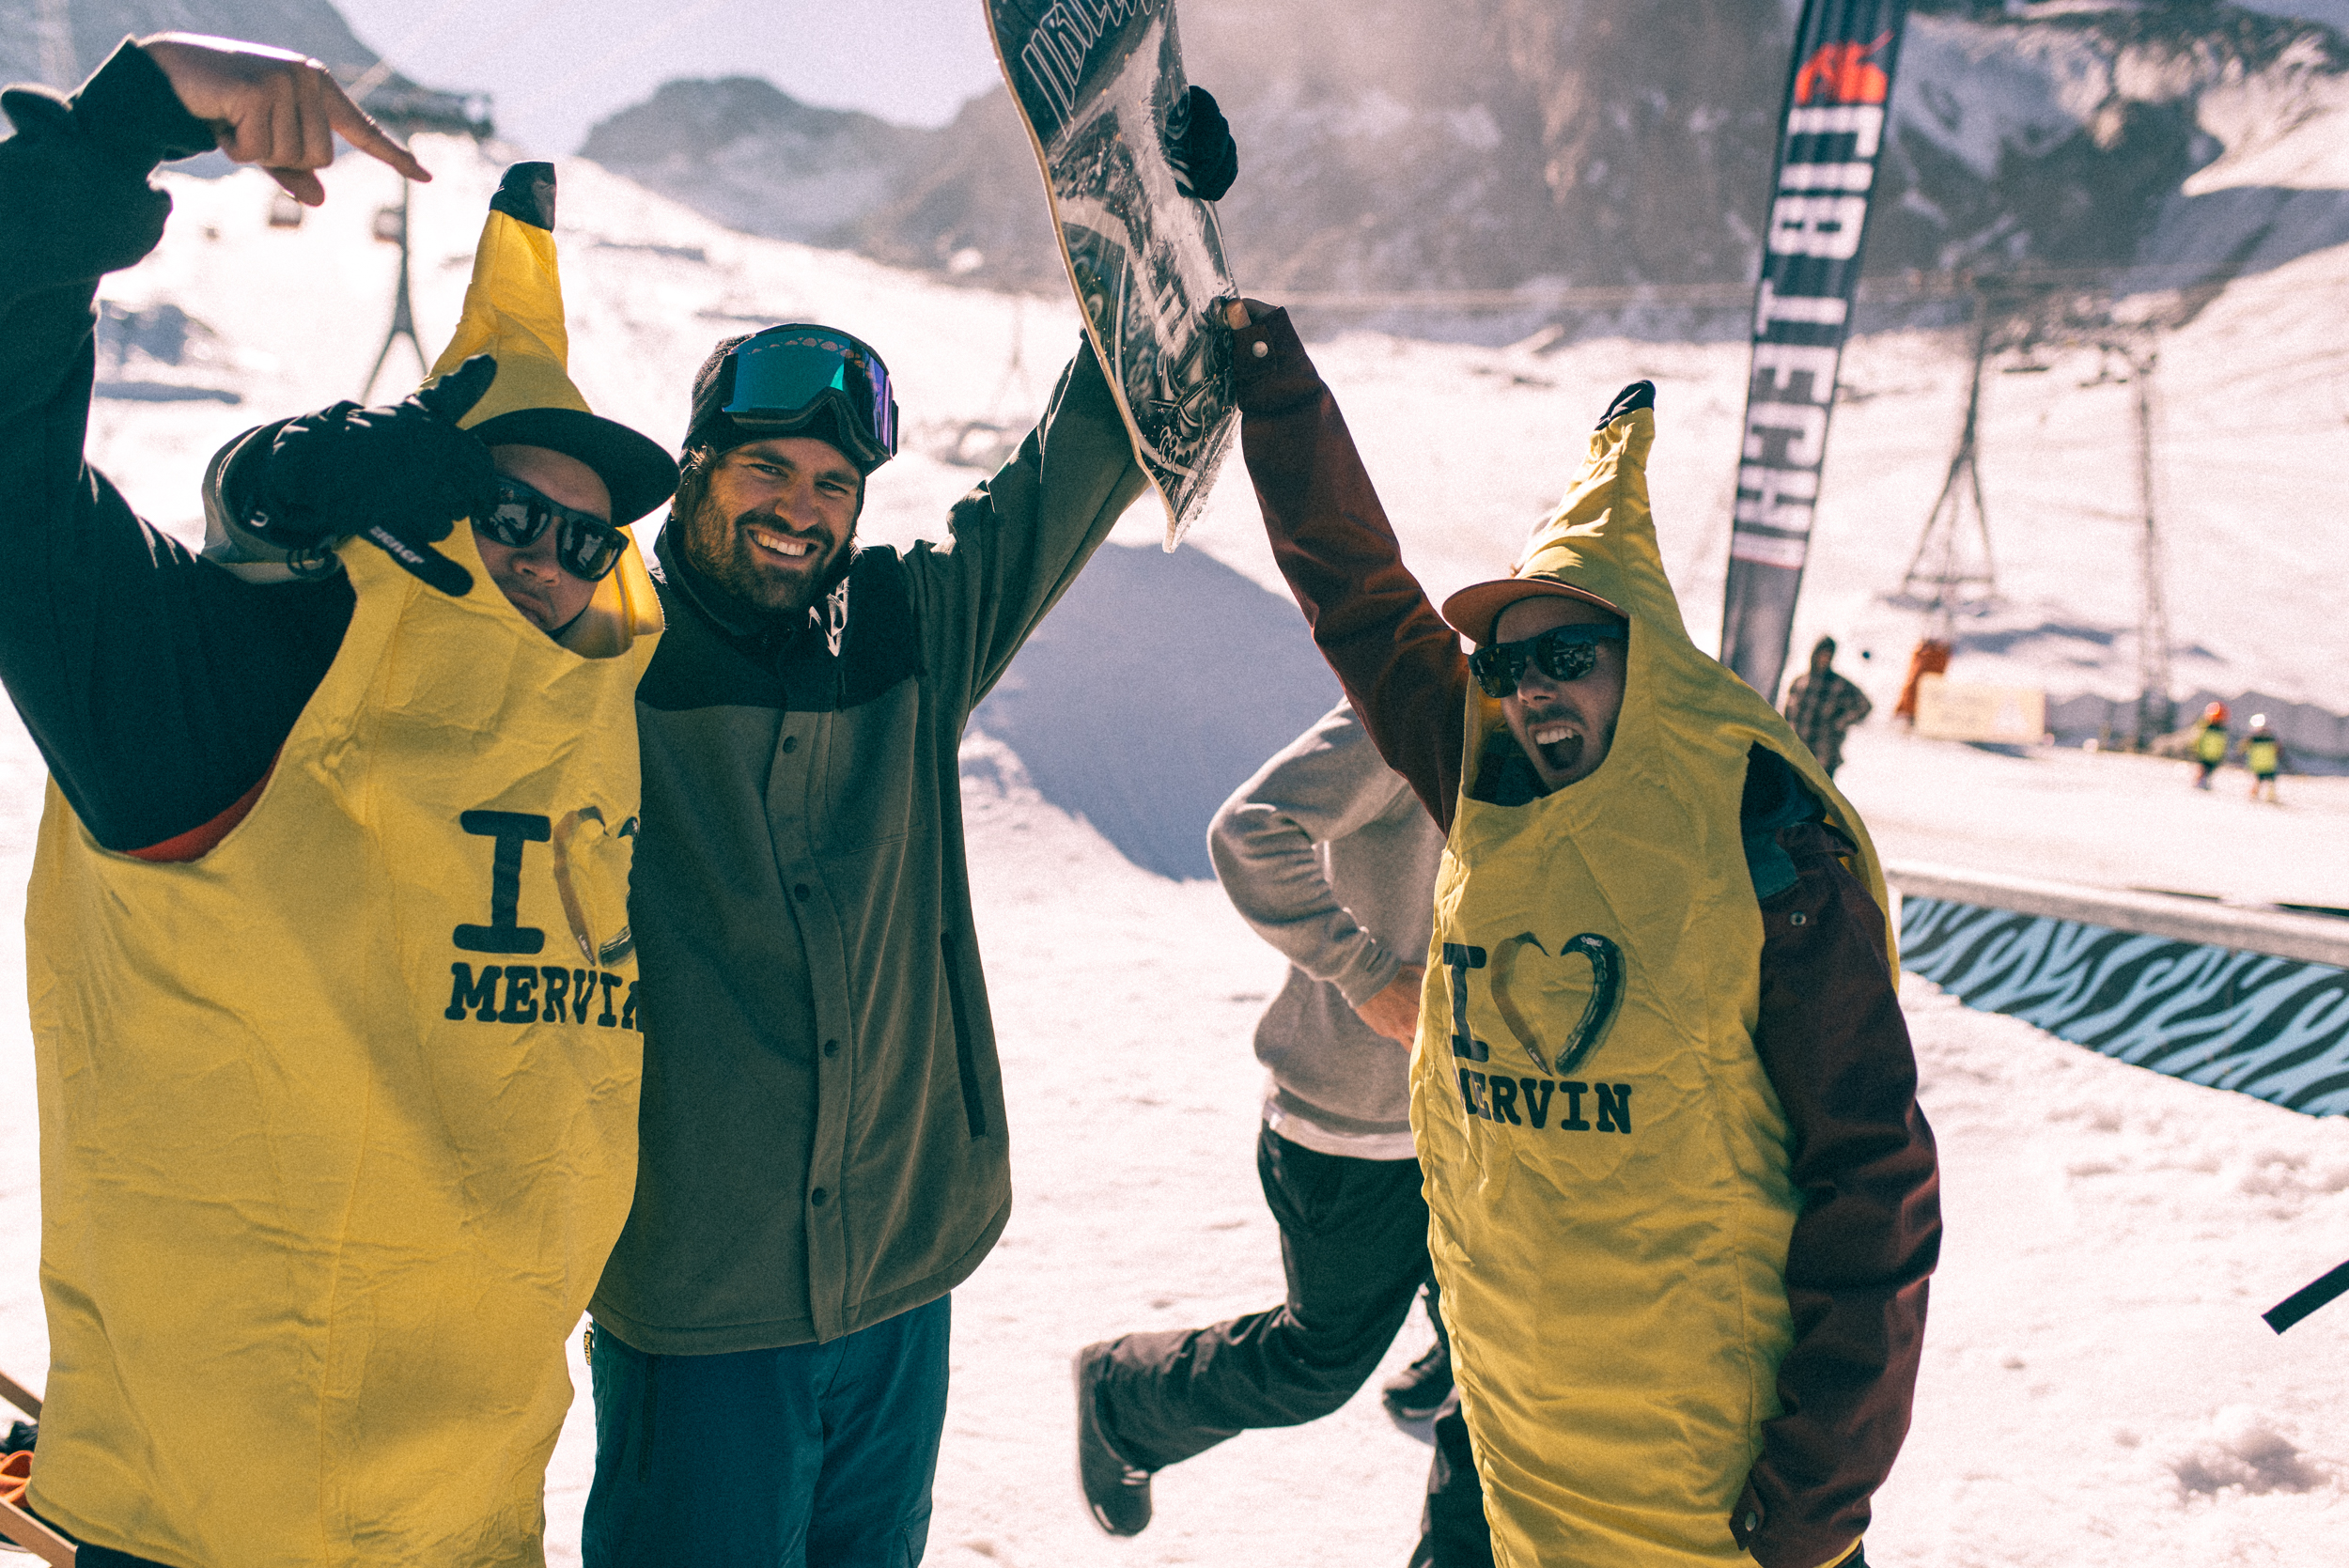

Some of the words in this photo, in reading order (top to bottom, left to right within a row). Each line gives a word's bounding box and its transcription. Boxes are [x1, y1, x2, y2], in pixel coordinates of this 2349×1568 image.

[452, 810, 552, 955] I
[1442, 942, 1489, 1063] I
[583, 1333, 592, 1366] FACTION
